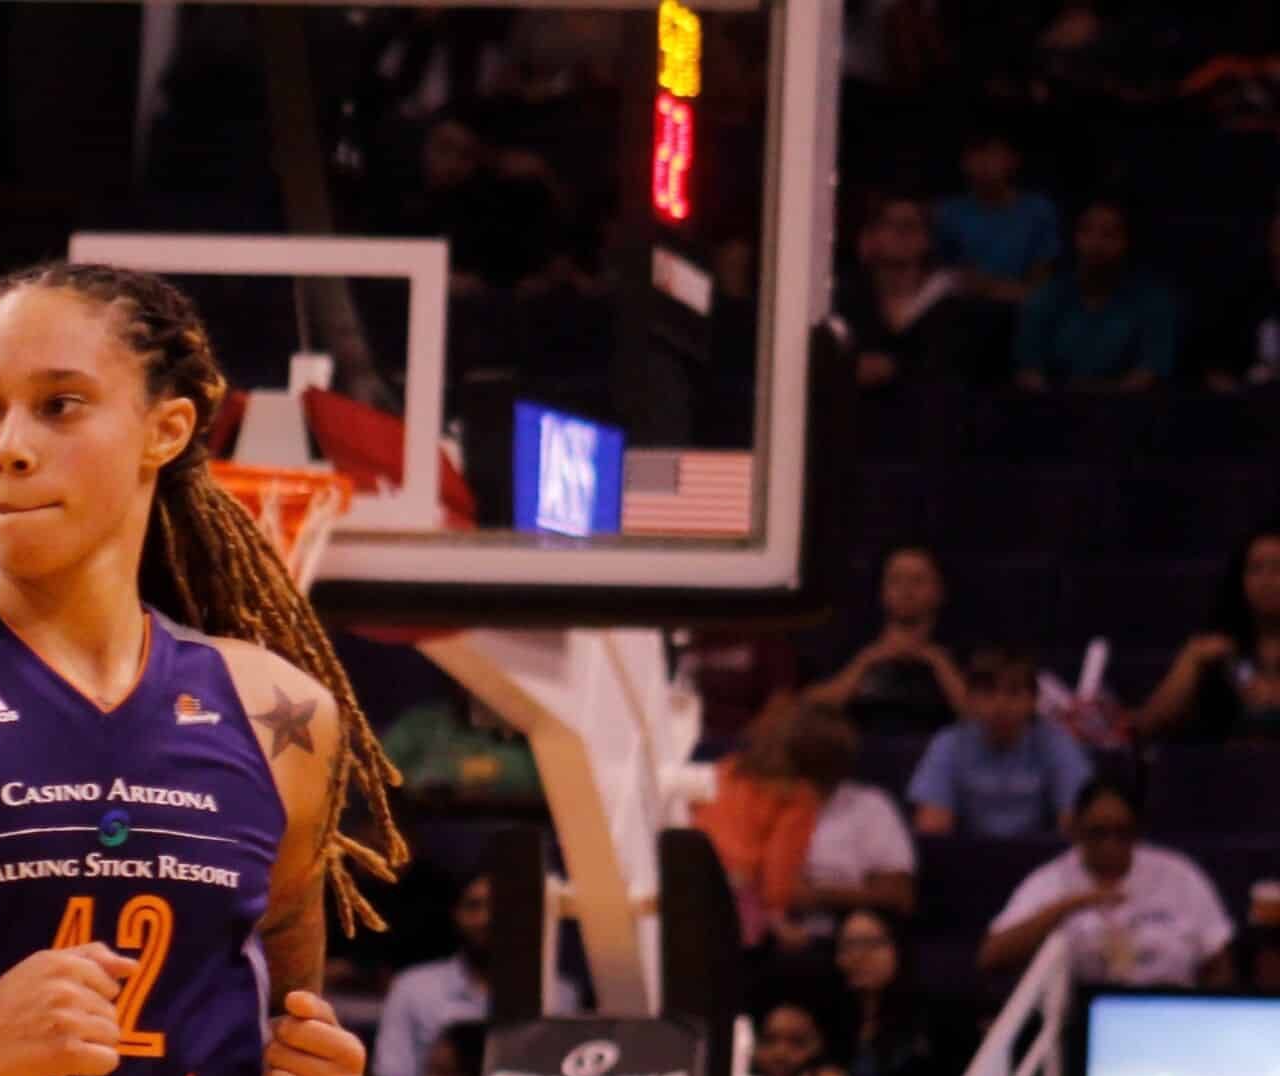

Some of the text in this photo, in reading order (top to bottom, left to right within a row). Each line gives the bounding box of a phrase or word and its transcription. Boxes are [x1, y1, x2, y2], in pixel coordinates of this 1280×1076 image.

[0, 778, 218, 812] CASINO ARIZONA
[84, 852, 153, 877] STICK
[158, 855, 240, 888] RESORT
